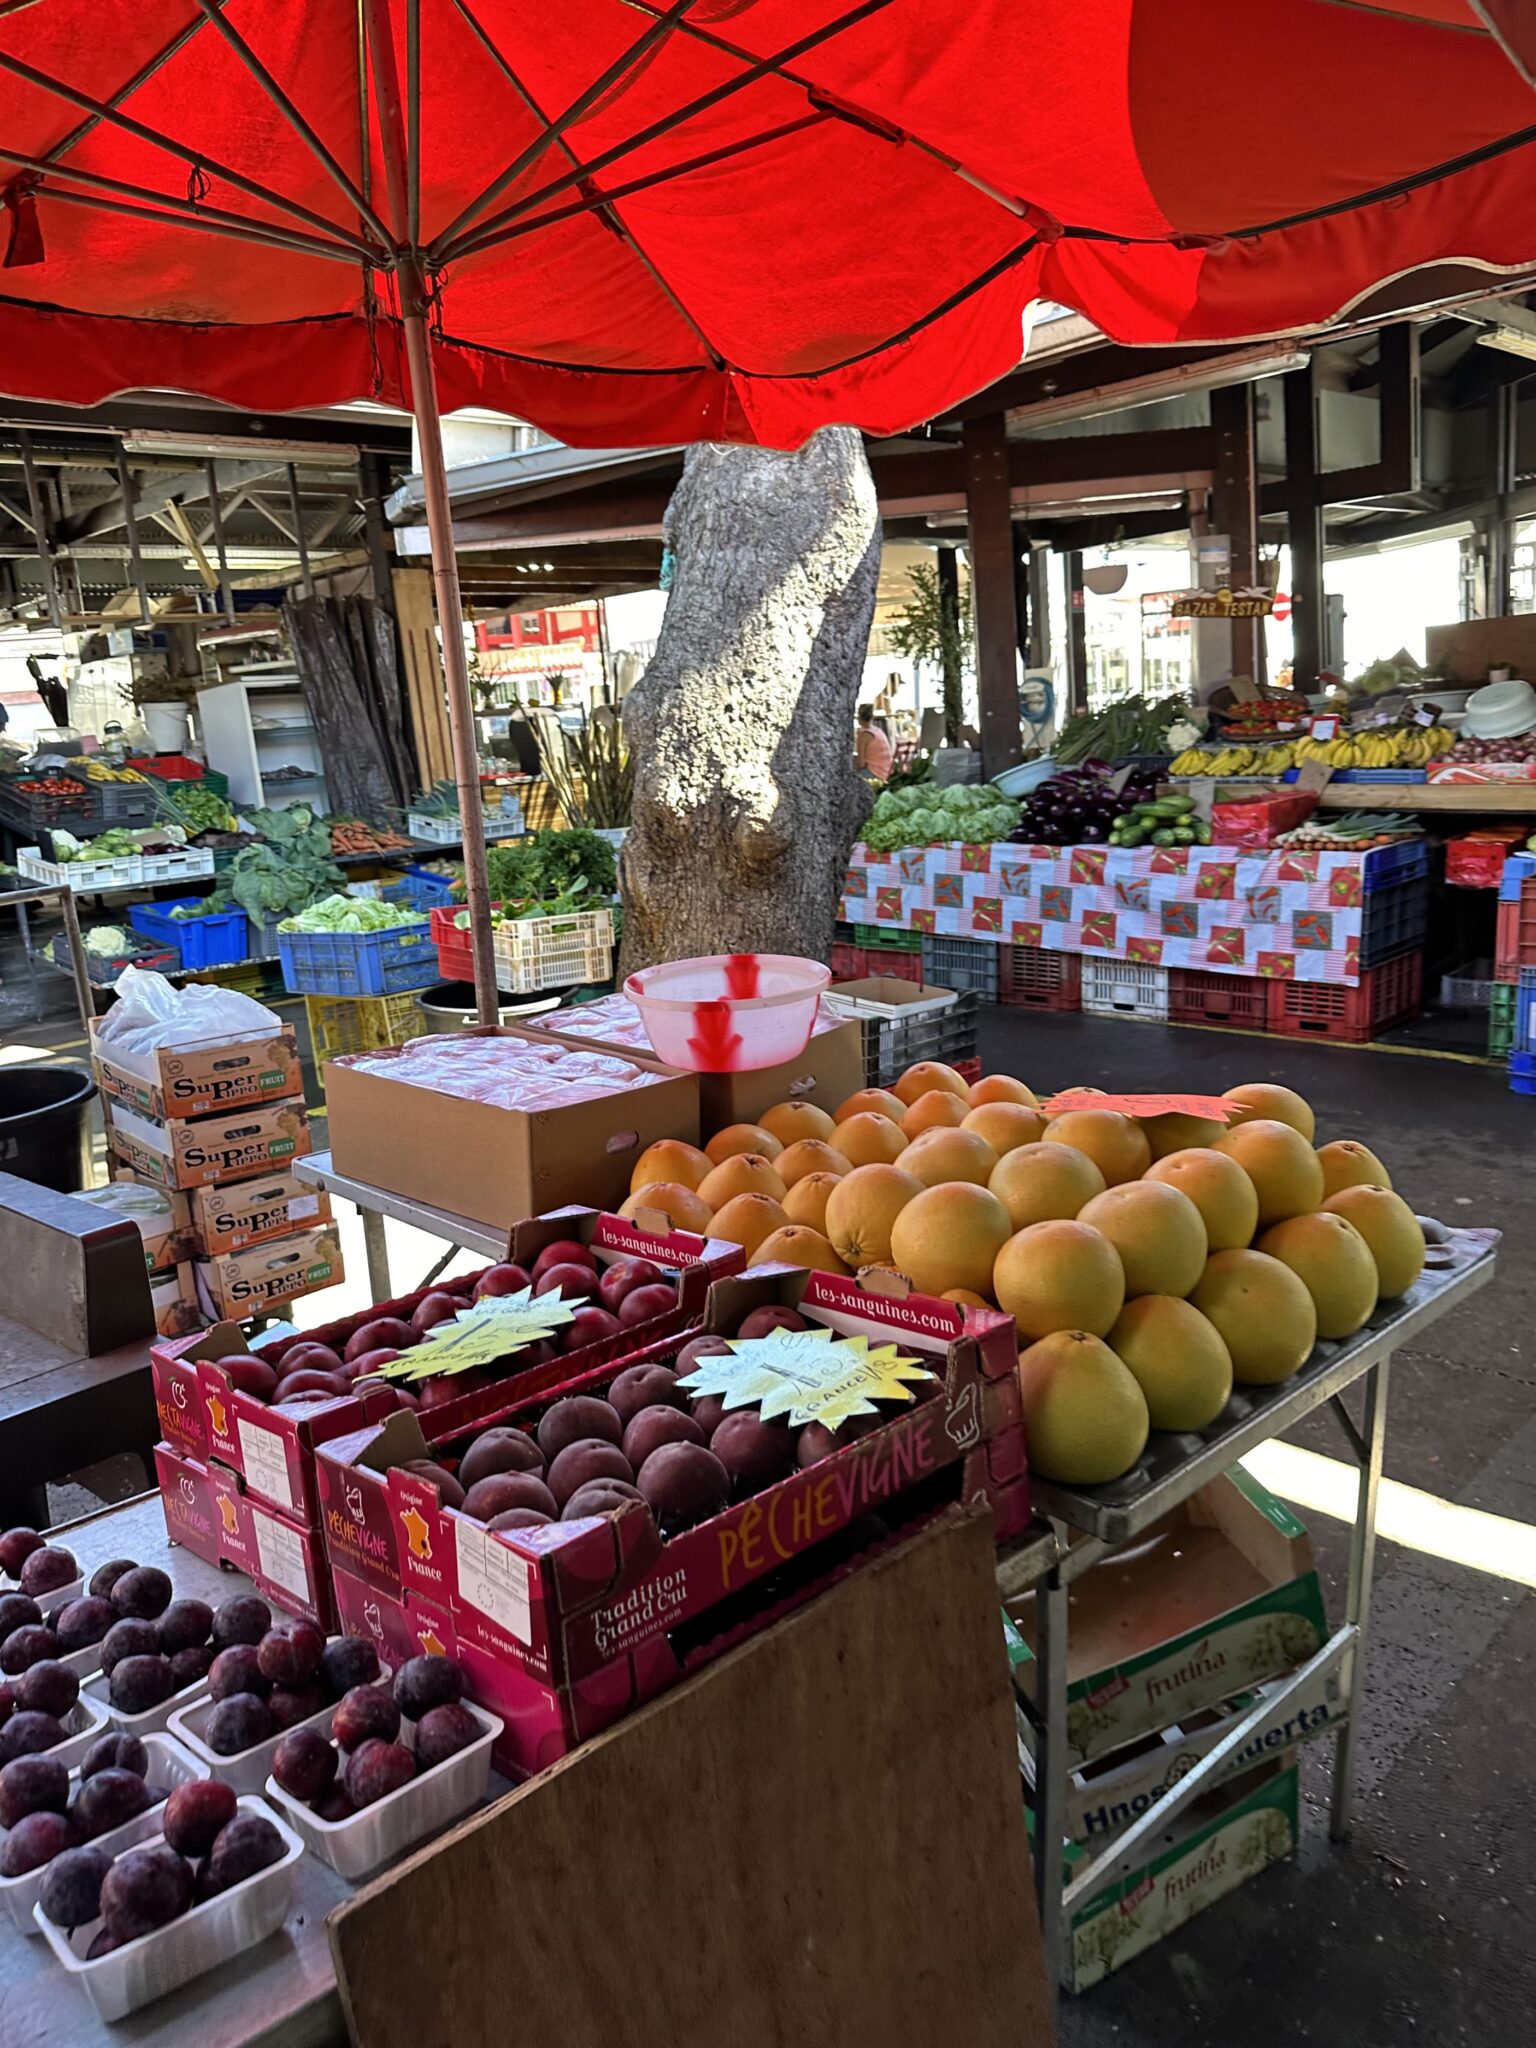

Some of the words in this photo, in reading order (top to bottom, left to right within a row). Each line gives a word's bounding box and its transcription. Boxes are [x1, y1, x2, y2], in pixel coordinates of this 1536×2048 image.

[1175, 602, 1217, 617] BAZAR
[259, 1074, 286, 1088] FRUIT
[269, 1141, 295, 1155] FRUIT
[307, 1265, 333, 1281] FRUIT
[814, 1281, 956, 1334] les-sanguines.com
[795, 1374, 868, 1420] FRANCE
[212, 1435, 236, 1454] France
[399, 1490, 424, 1507] Origine
[718, 1419, 937, 1589] PÊCHEVIGNE
[222, 1533, 247, 1553] France
[362, 1553, 385, 1574] Grand
[407, 1556, 443, 1582] France
[590, 1567, 687, 1630] Tradition
[594, 1599, 654, 1652] Grand
[656, 1585, 688, 1612] Cru
[602, 1607, 682, 1660] les-sanguines.com
[1145, 1649, 1227, 1705] frutina
[1164, 1848, 1228, 1906] frutina
